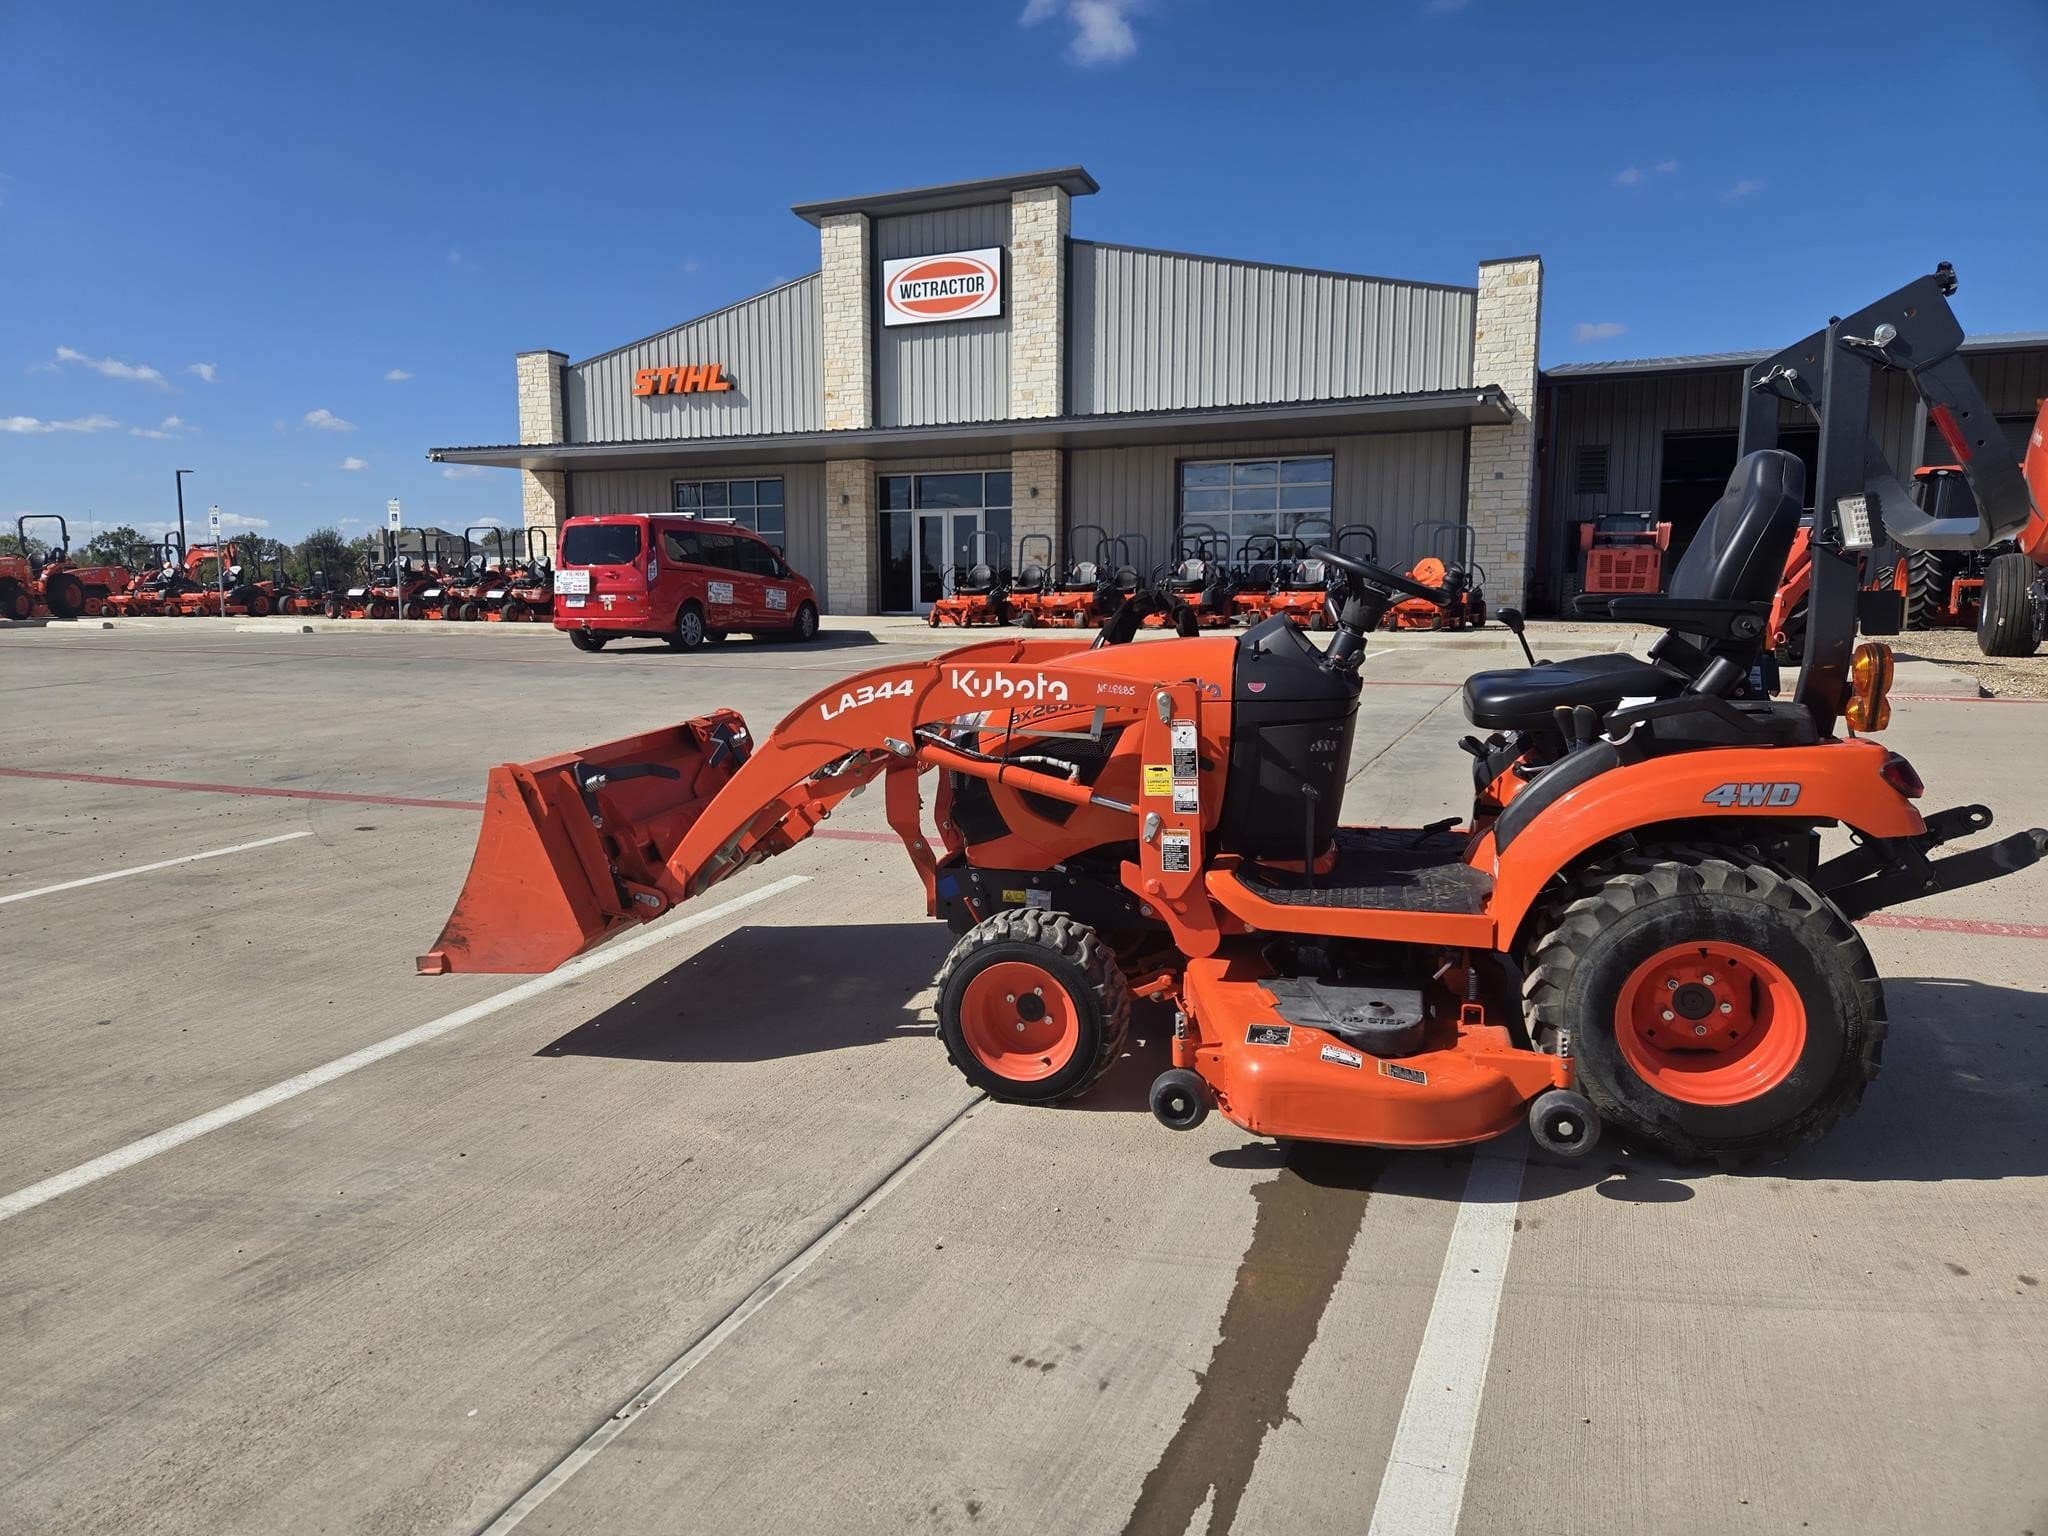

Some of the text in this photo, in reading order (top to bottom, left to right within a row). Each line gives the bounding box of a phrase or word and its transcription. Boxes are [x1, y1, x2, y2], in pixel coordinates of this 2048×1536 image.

[899, 274, 986, 301] WCTRACTOR
[632, 363, 731, 397] STIHL
[952, 669, 1069, 701] Kubota
[819, 679, 914, 721] LA344
[1702, 782, 1801, 808] 4WD
[1341, 1015, 1407, 1026] NO STEP
